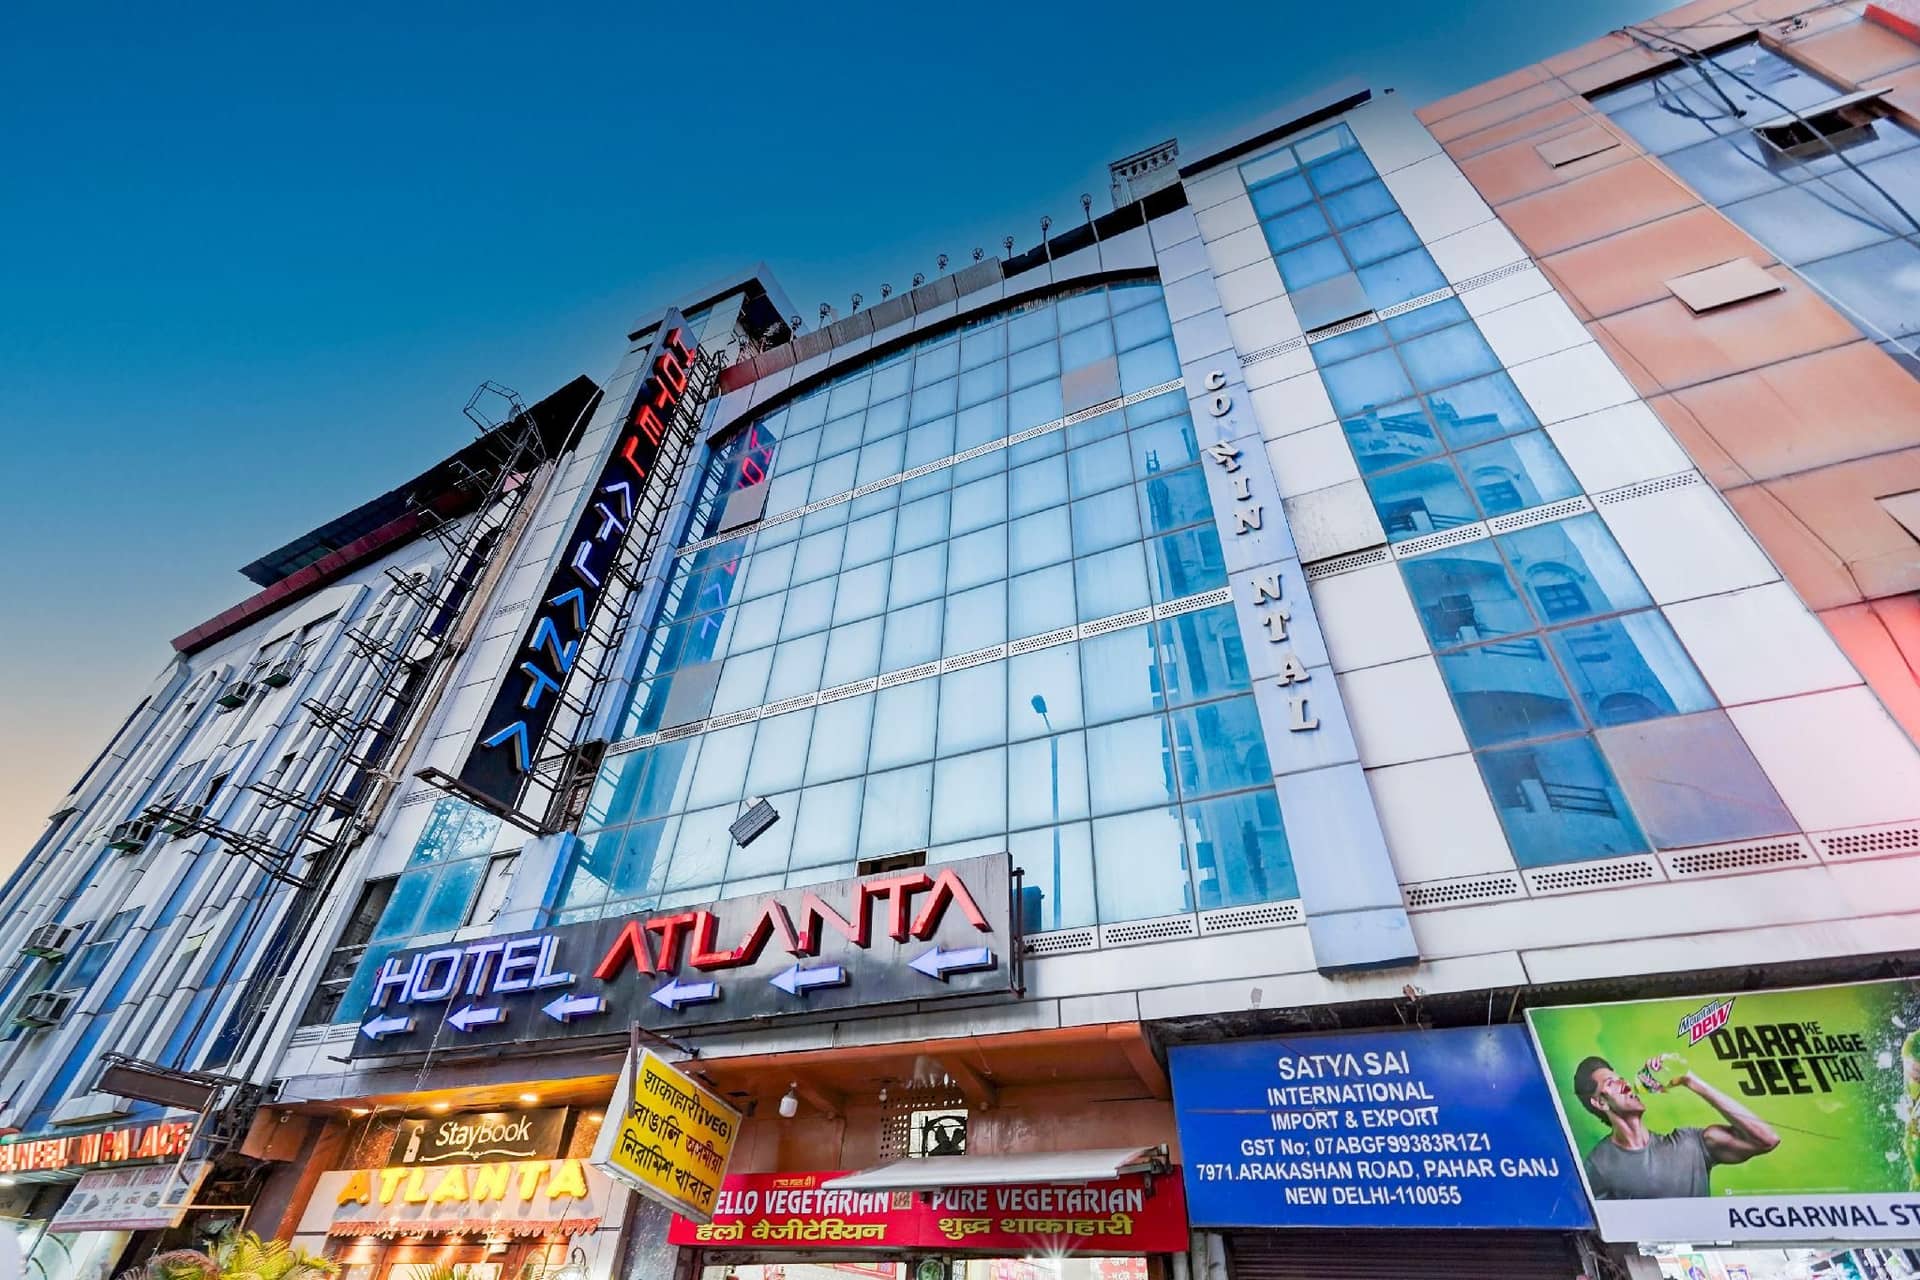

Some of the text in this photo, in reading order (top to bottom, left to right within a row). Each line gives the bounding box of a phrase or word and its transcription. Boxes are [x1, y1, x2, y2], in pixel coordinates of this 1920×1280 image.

[621, 327, 696, 479] HOTEL
[481, 481, 633, 774] ATLANTA
[372, 867, 994, 1007] HOTEL ATLANTA
[1708, 1021, 1823, 1061] DARR KE
[1812, 1033, 1867, 1054] AAGE
[1279, 1050, 1410, 1081] SATYA SAI
[1731, 1055, 1865, 1097] JEET HAI
[1267, 1080, 1434, 1107] INTERNATIONAL
[435, 1114, 530, 1151] StayBook
[1271, 1105, 1440, 1132] IMPORT & EXPORT
[1240, 1138, 1276, 1157] GST
[336, 1158, 588, 1205] ATLANTA
[1357, 1160, 1419, 1180] ROAD,
[1424, 1158, 1496, 1179] PAHAR
[1500, 1157, 1560, 1178] GANJ
[712, 1188, 889, 1216] ELLO VEGETARIAN
[931, 1187, 1143, 1214] PURE VEGETARIAN
[1285, 1184, 1463, 1206] NEW DELHI-110055
[1729, 1203, 1887, 1228] AGGARWAL
